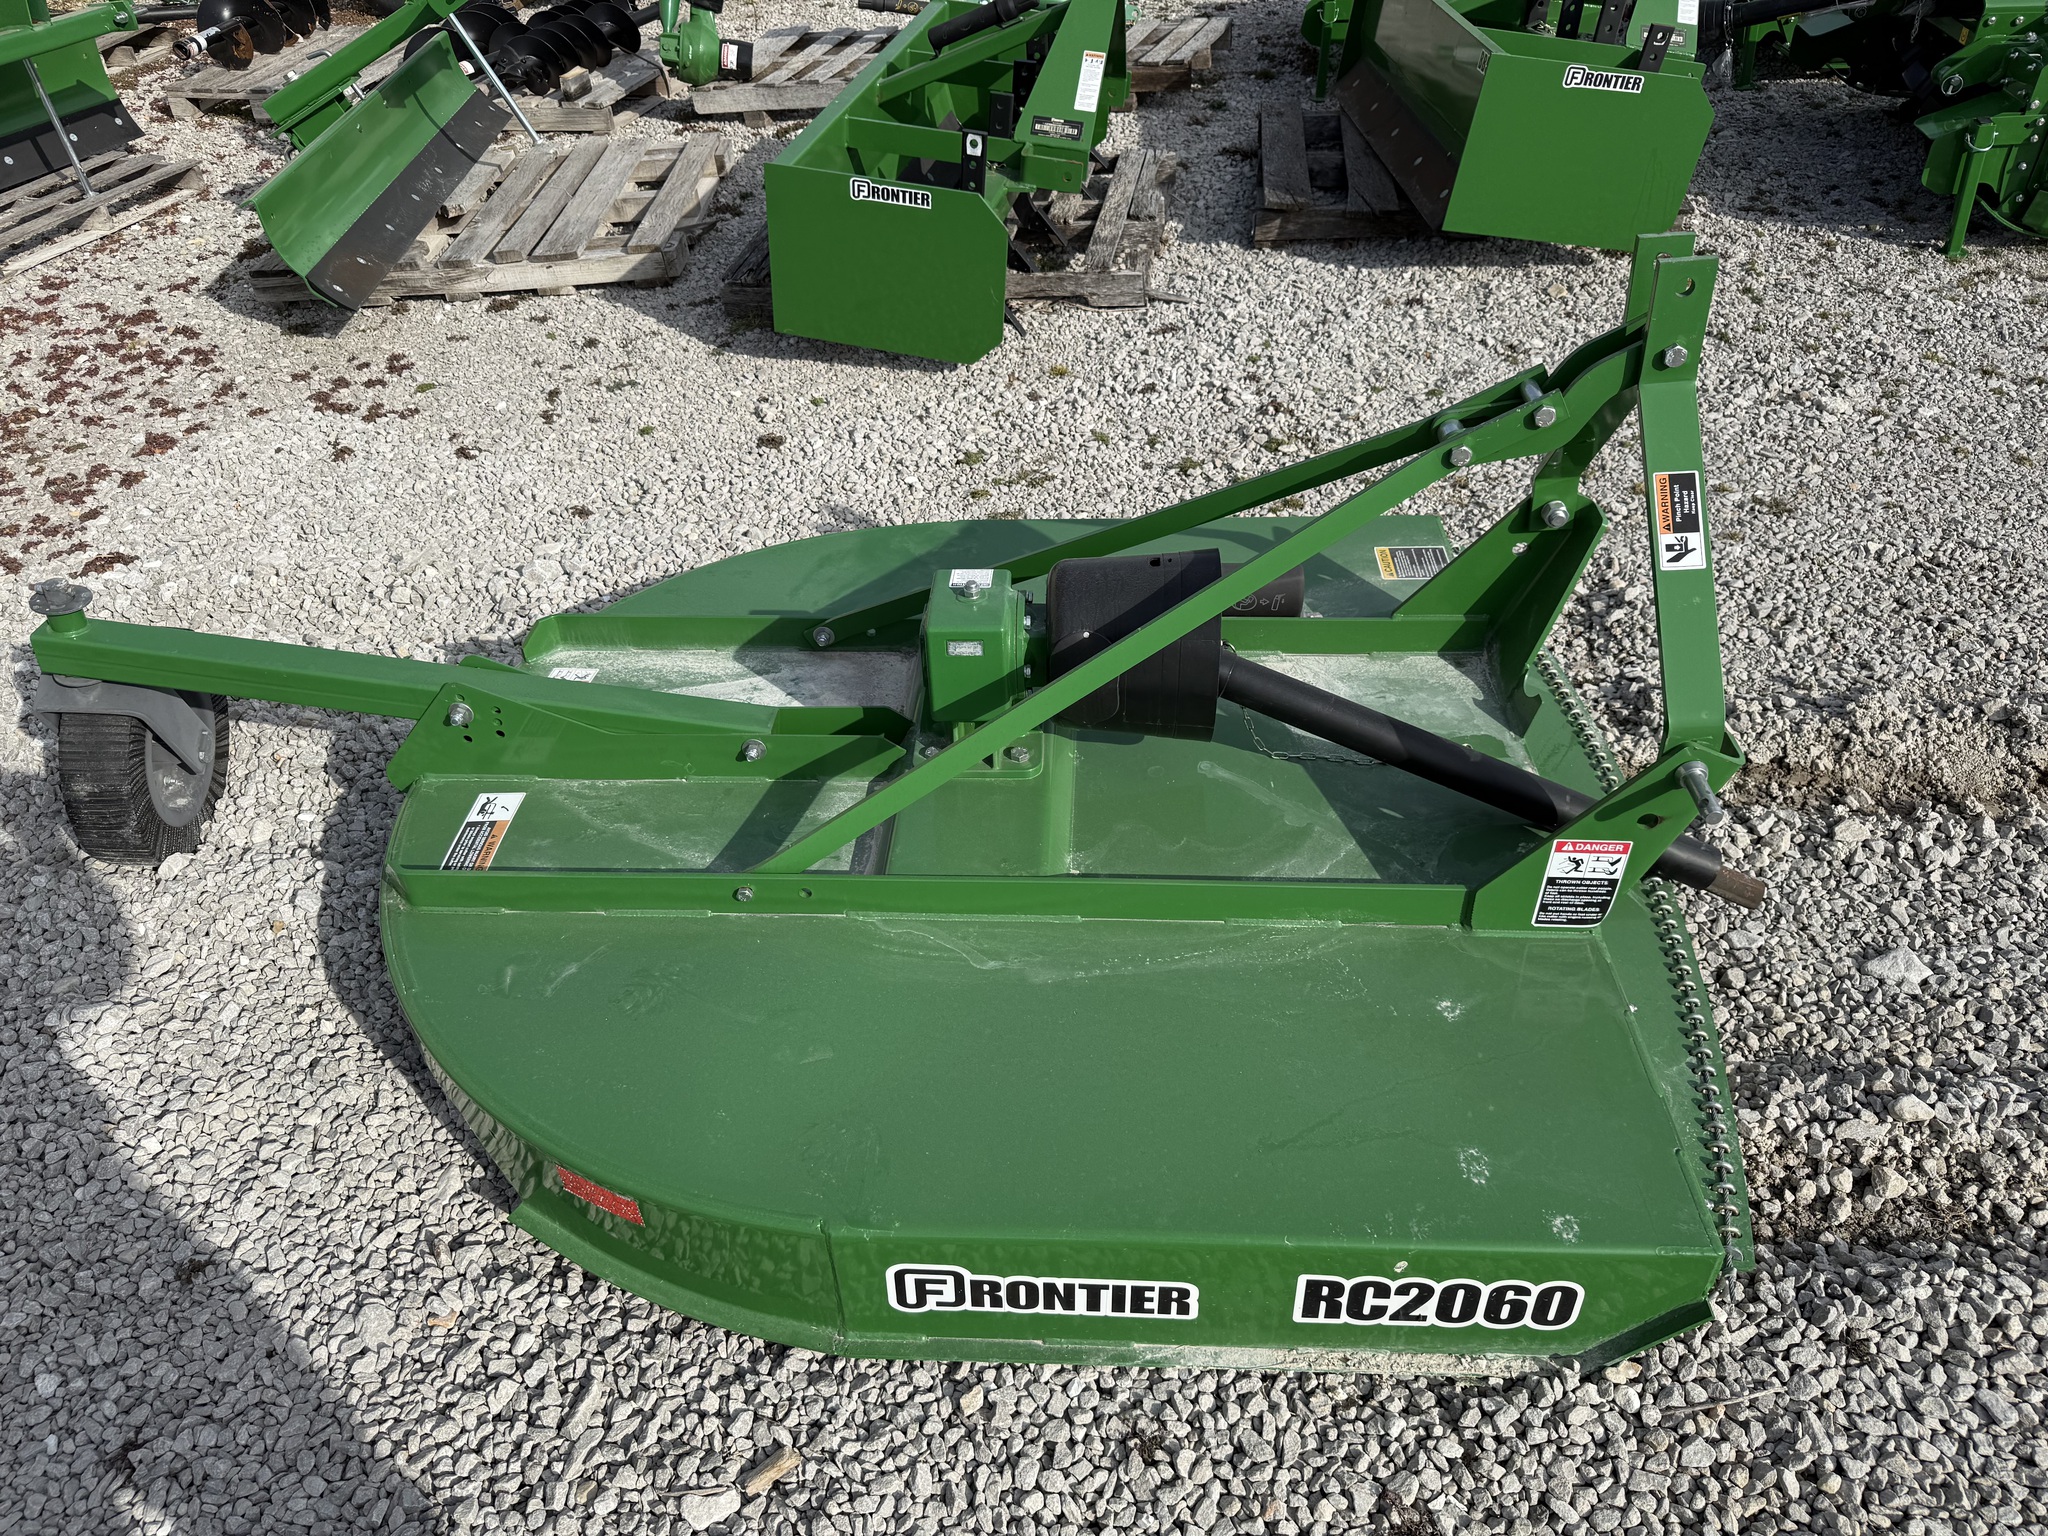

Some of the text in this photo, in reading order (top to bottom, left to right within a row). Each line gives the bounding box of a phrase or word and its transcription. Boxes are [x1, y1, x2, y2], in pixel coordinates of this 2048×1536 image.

[1564, 66, 1643, 91] FRONTIER
[852, 180, 930, 207] FRONTIER
[1659, 477, 1671, 523] WARNING
[1673, 484, 1681, 502] Point
[1682, 490, 1690, 514] Hazard
[1379, 549, 1393, 573] CAUTION
[1575, 843, 1624, 852] DANGER
[894, 1268, 1191, 1316] FRONTIER
[1301, 1278, 1579, 1327] RC2060
